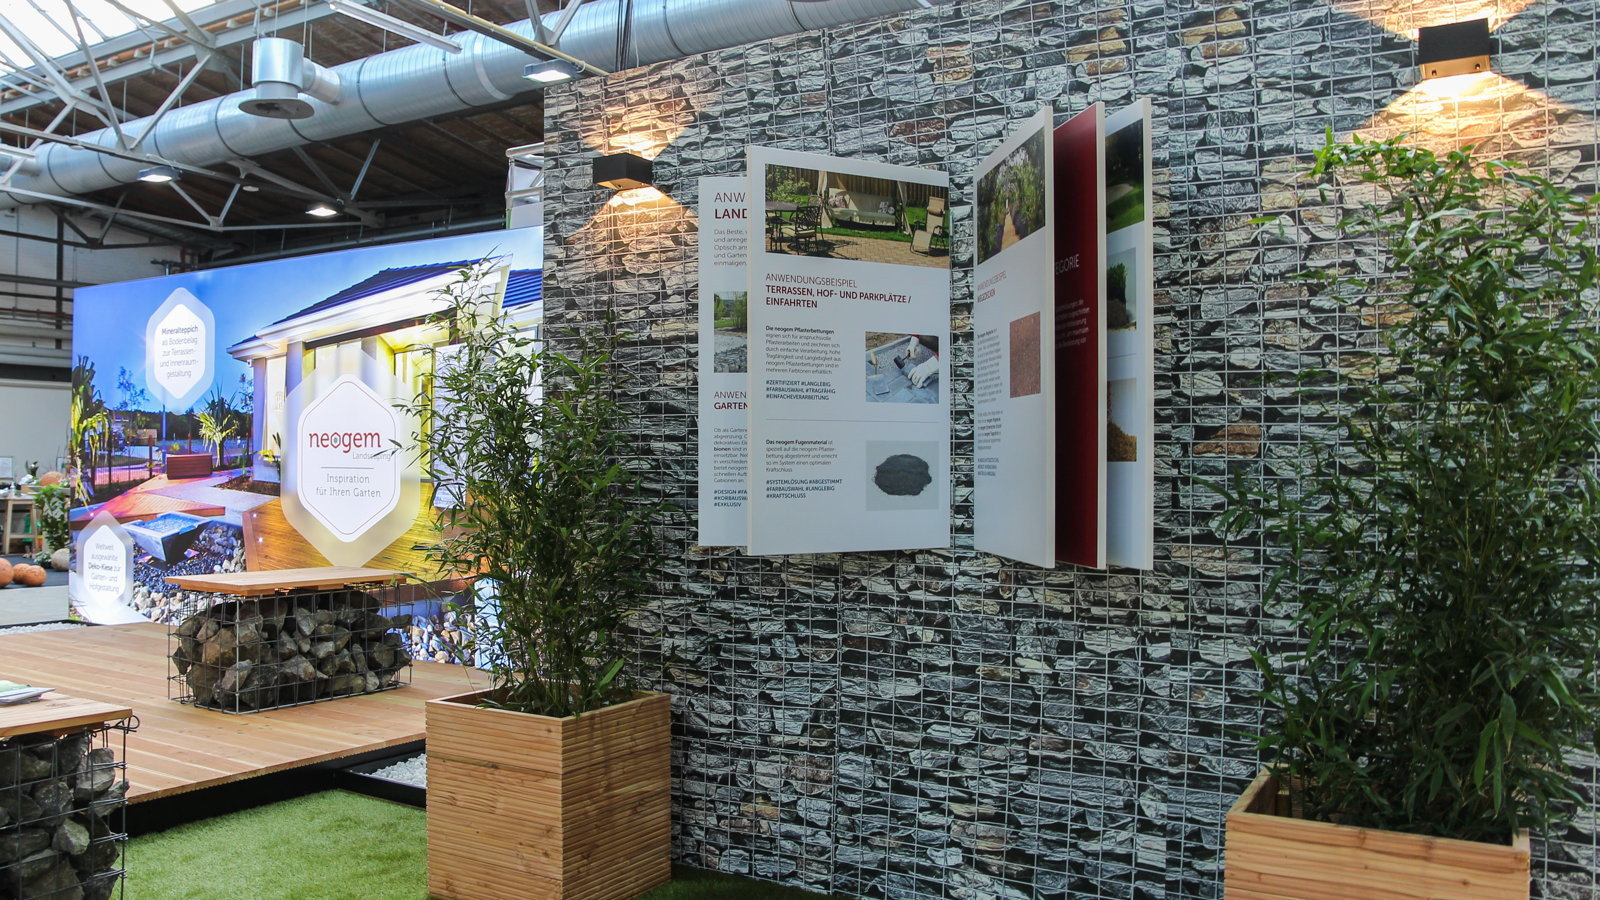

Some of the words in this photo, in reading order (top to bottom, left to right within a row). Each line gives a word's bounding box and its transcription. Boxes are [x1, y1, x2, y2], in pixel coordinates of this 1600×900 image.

[714, 192, 746, 203] ANW
[766, 273, 857, 288] ANWENDUNGSBEISPIEL
[766, 285, 815, 297] TERRASSEN,
[817, 288, 837, 298] HOF-
[839, 291, 857, 300] UND
[859, 291, 906, 303] PARKPLÄTZE
[766, 297, 817, 308] EINFAHRTEN
[162, 325, 198, 335] Mineralteppich
[794, 327, 834, 335] Pflasterbettungen
[167, 370, 191, 379] gestaltung
[766, 393, 829, 401] #EINFACHEVERARBEITUNG
[309, 432, 381, 454] neogem
[327, 474, 369, 484] Inspiration
[316, 487, 327, 496] für
[330, 487, 350, 496] Ihren
[354, 487, 381, 497] Garten
[88, 562, 112, 571] Deko-Kiese
